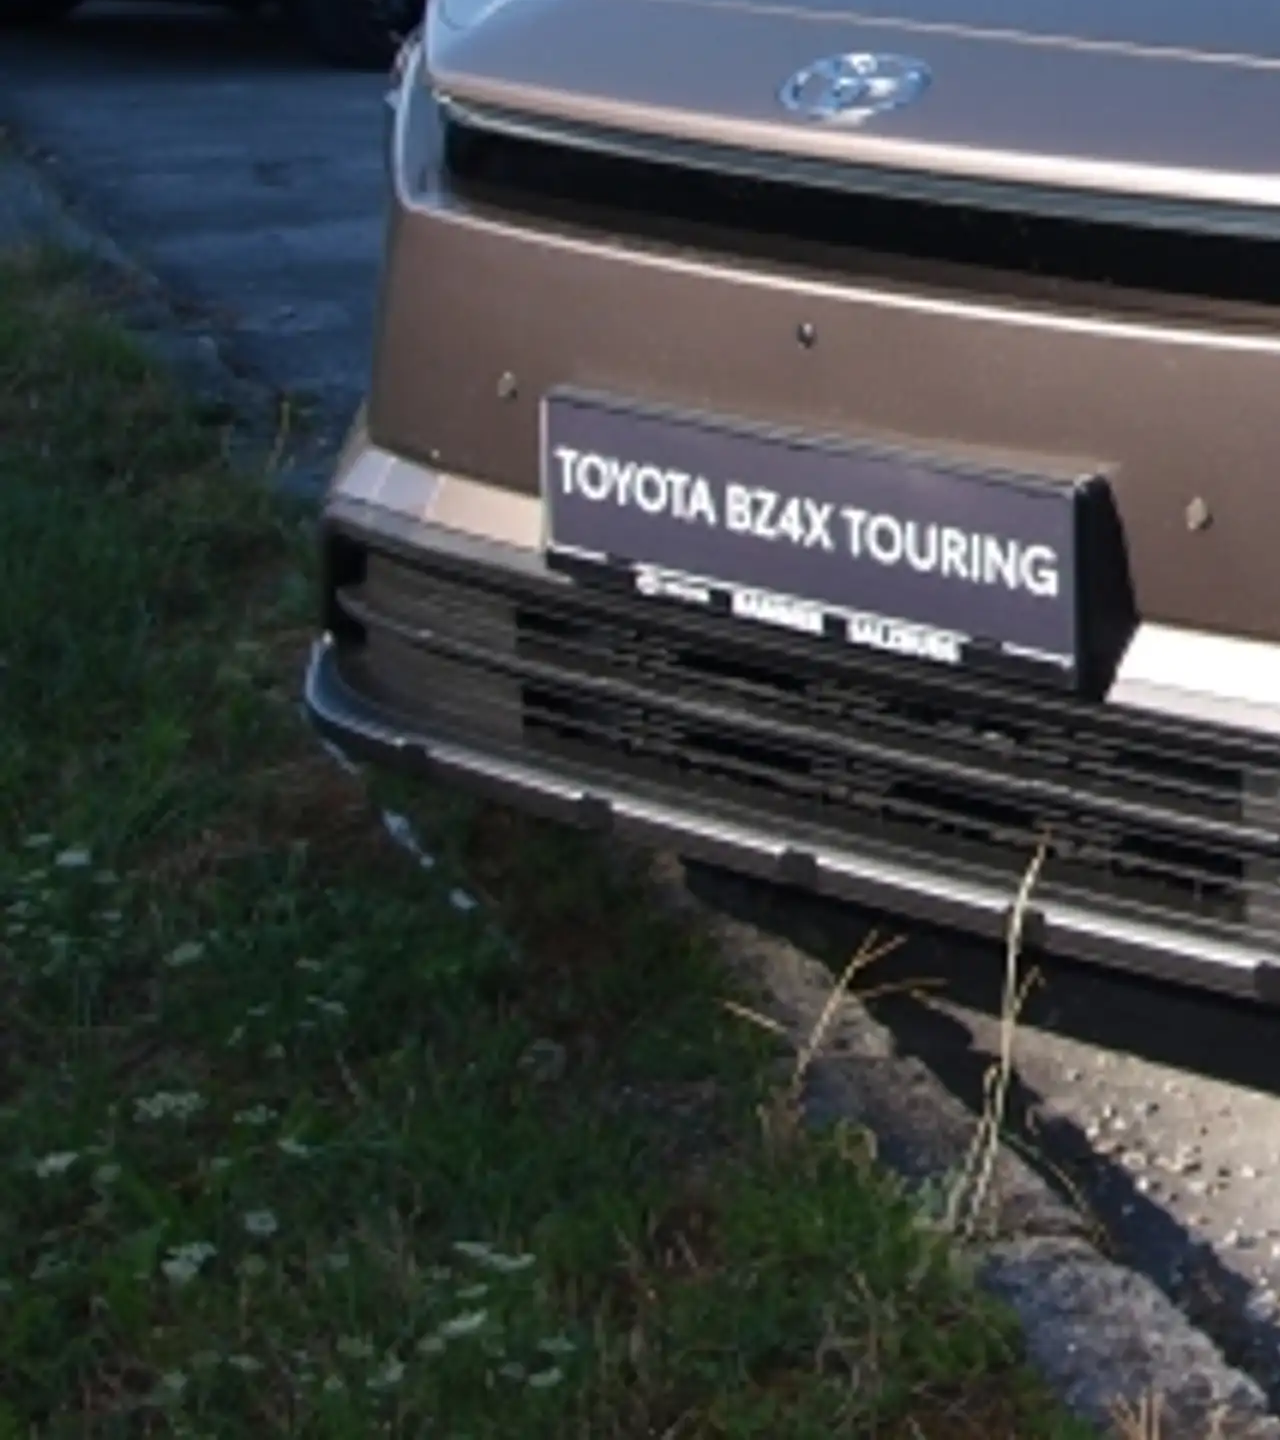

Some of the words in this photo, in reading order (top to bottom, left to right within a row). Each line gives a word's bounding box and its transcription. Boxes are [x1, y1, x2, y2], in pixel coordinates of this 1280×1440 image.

[553, 447, 717, 527] TOYOTA
[725, 484, 834, 551] BZ4X
[840, 507, 1060, 598] TOURING
